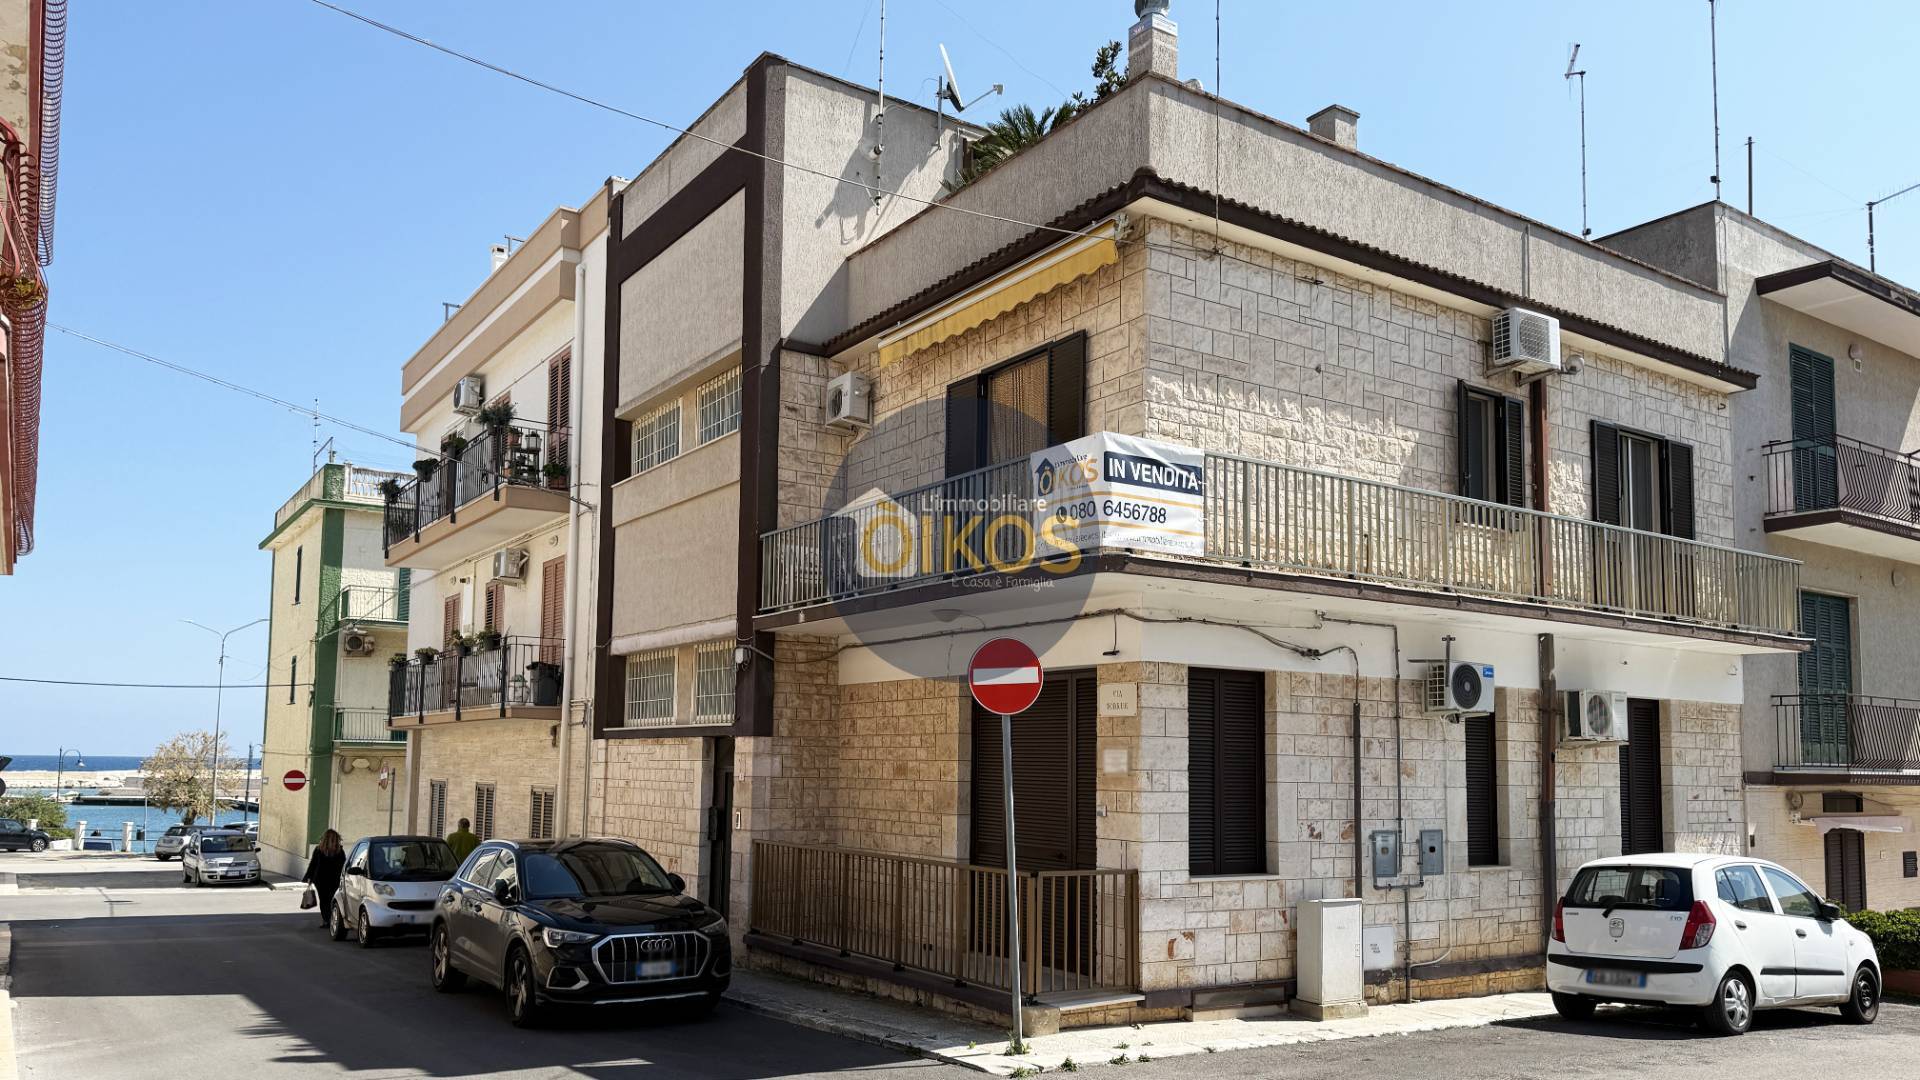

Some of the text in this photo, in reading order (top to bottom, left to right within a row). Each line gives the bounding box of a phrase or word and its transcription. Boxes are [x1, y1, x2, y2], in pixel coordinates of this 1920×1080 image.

[1109, 457, 1126, 479] IN
[1129, 461, 1200, 492] VENDITA
[1070, 499, 1167, 524] 080 6456788
